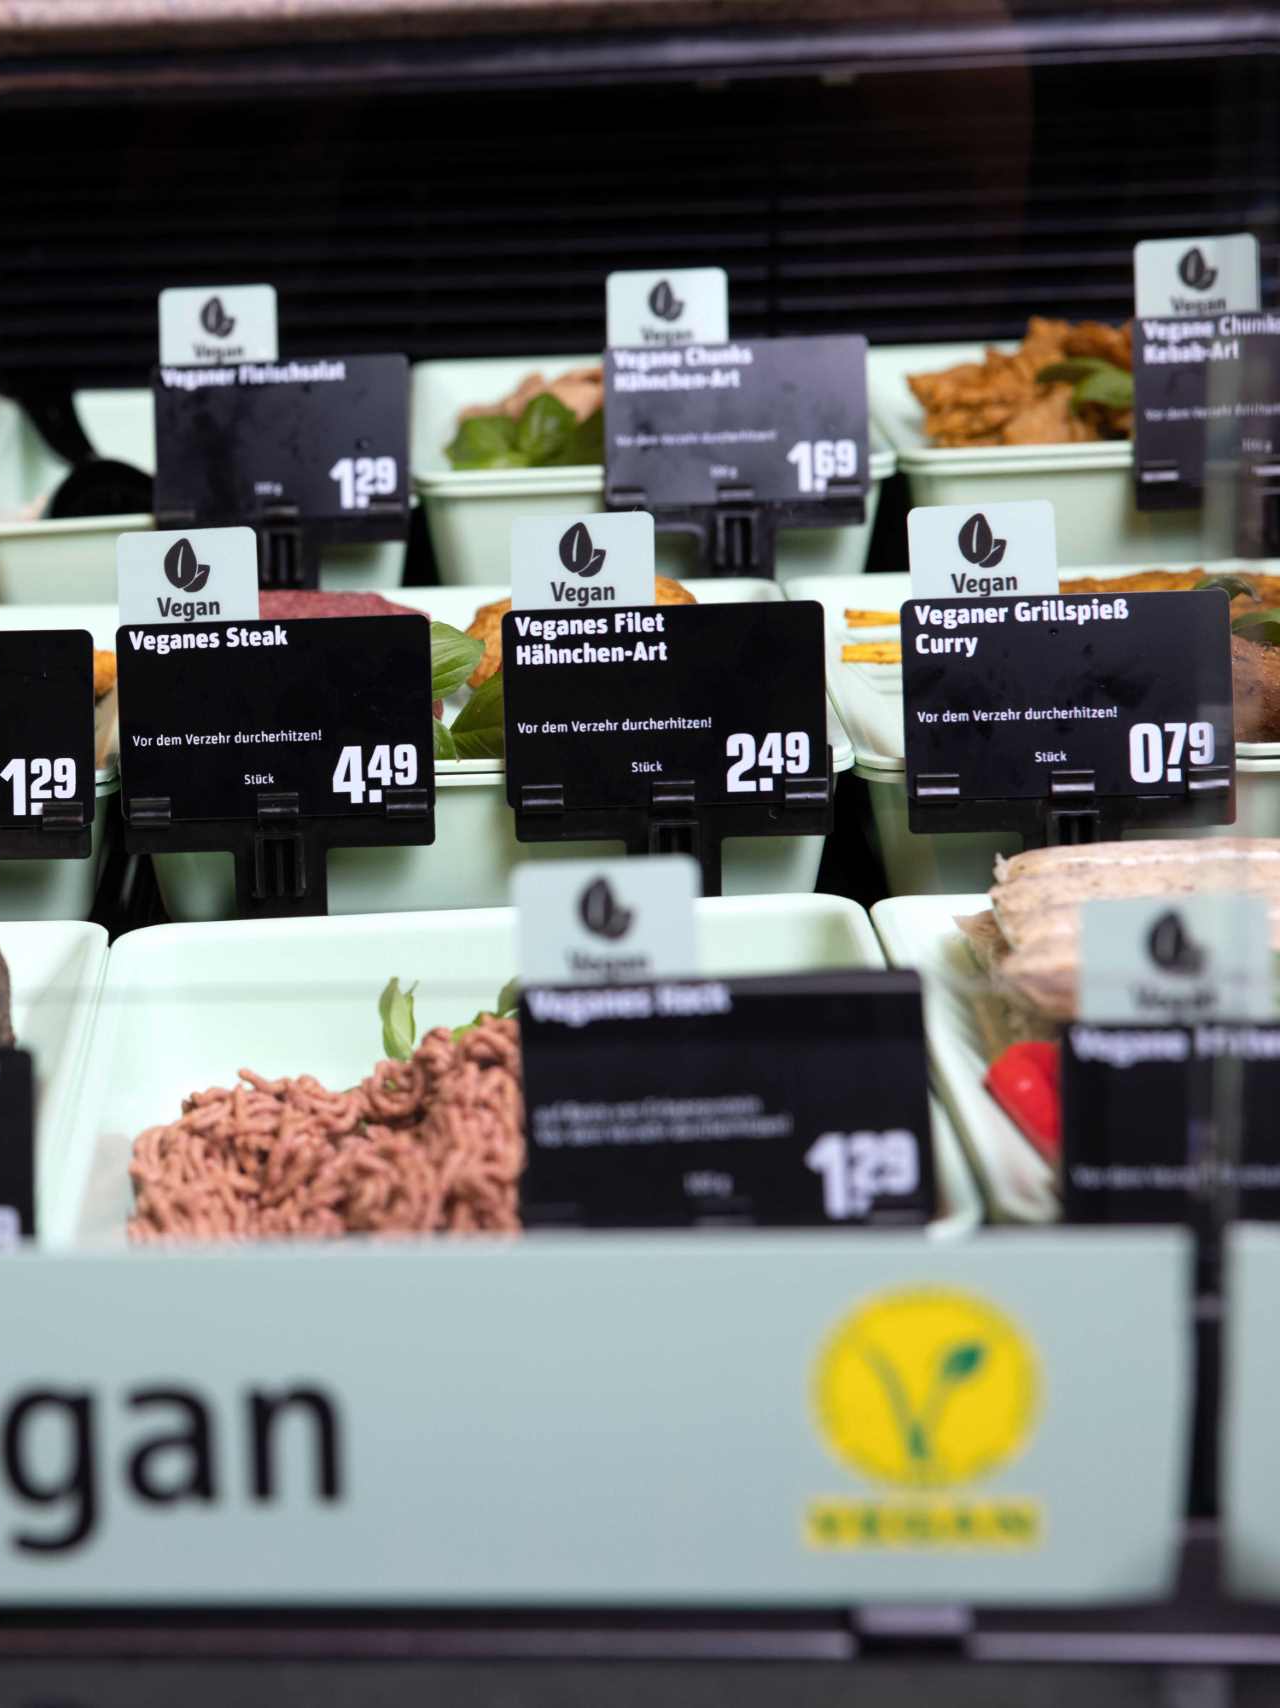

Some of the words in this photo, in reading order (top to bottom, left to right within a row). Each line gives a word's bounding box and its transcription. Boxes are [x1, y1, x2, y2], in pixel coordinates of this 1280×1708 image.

[1219, 316, 1280, 336] Chunk
[685, 345, 753, 367] Chunks
[550, 581, 615, 607] Vegan
[951, 573, 1018, 597] Vegan
[157, 597, 220, 621] Vegan
[915, 604, 1008, 629] Veganer
[1014, 598, 1129, 625] Grillspieß
[515, 617, 608, 641] Veganes
[615, 612, 665, 634] Filet
[129, 630, 220, 655] Veganes
[226, 625, 288, 648] Steak
[915, 633, 978, 658] Curry
[516, 641, 668, 665] Hähnchen-Art
[517, 722, 538, 734] Vor
[542, 720, 568, 733] dem
[571, 719, 619, 732] Verzehr
[622, 716, 712, 731] durcherhitzen!
[917, 710, 939, 723] Vor
[942, 709, 970, 723] dem
[972, 708, 1021, 722] Verzehr
[1024, 706, 1118, 721] durcherhitzen!
[132, 735, 153, 747] Vor
[156, 733, 182, 746] dem
[185, 732, 231, 745] Verzehr
[234, 729, 322, 744] durcherhitzen!
[631, 761, 663, 773] Stück
[1034, 751, 1067, 763] Stück
[244, 773, 274, 785] Stück
